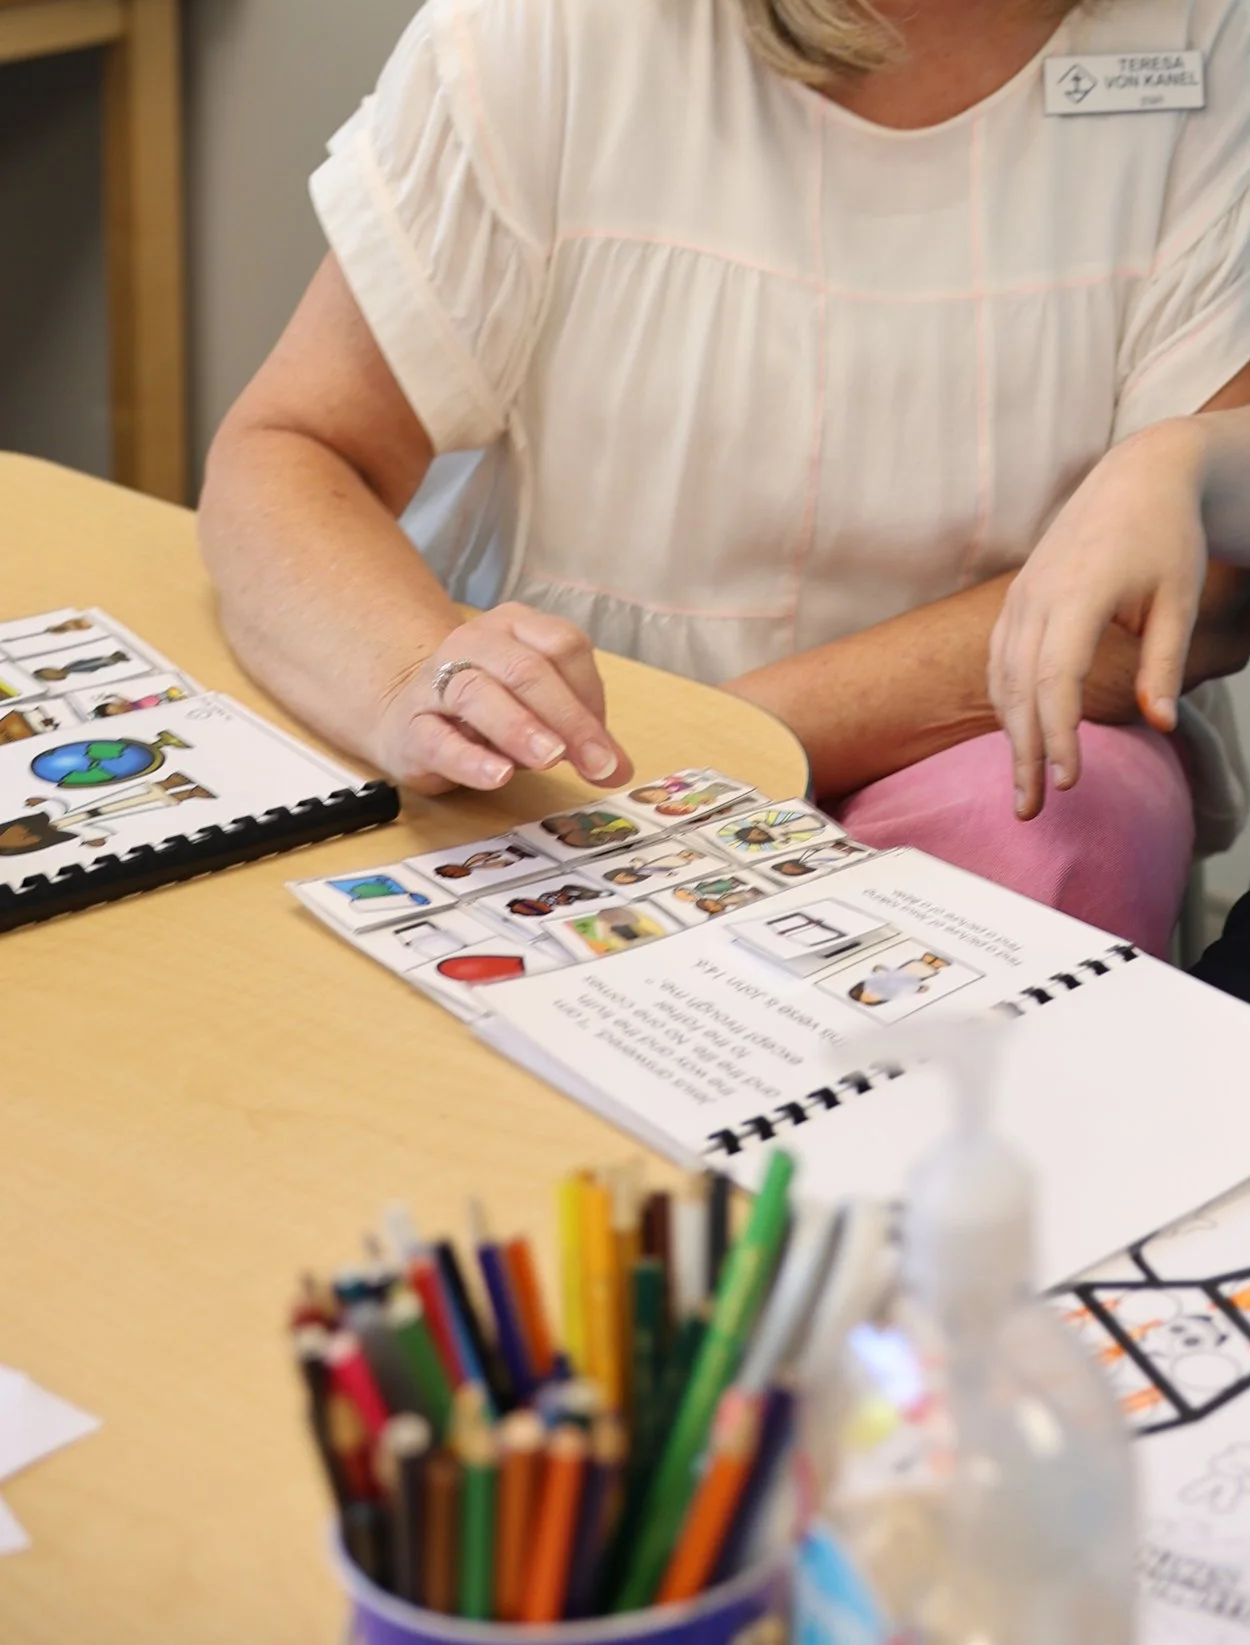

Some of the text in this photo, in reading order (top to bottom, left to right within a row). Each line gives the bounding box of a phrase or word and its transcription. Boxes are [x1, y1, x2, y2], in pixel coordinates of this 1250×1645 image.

[1119, 56, 1184, 72] TERESA
[1103, 70, 1200, 90] VON KANEL
[583, 975, 636, 1010] comes
